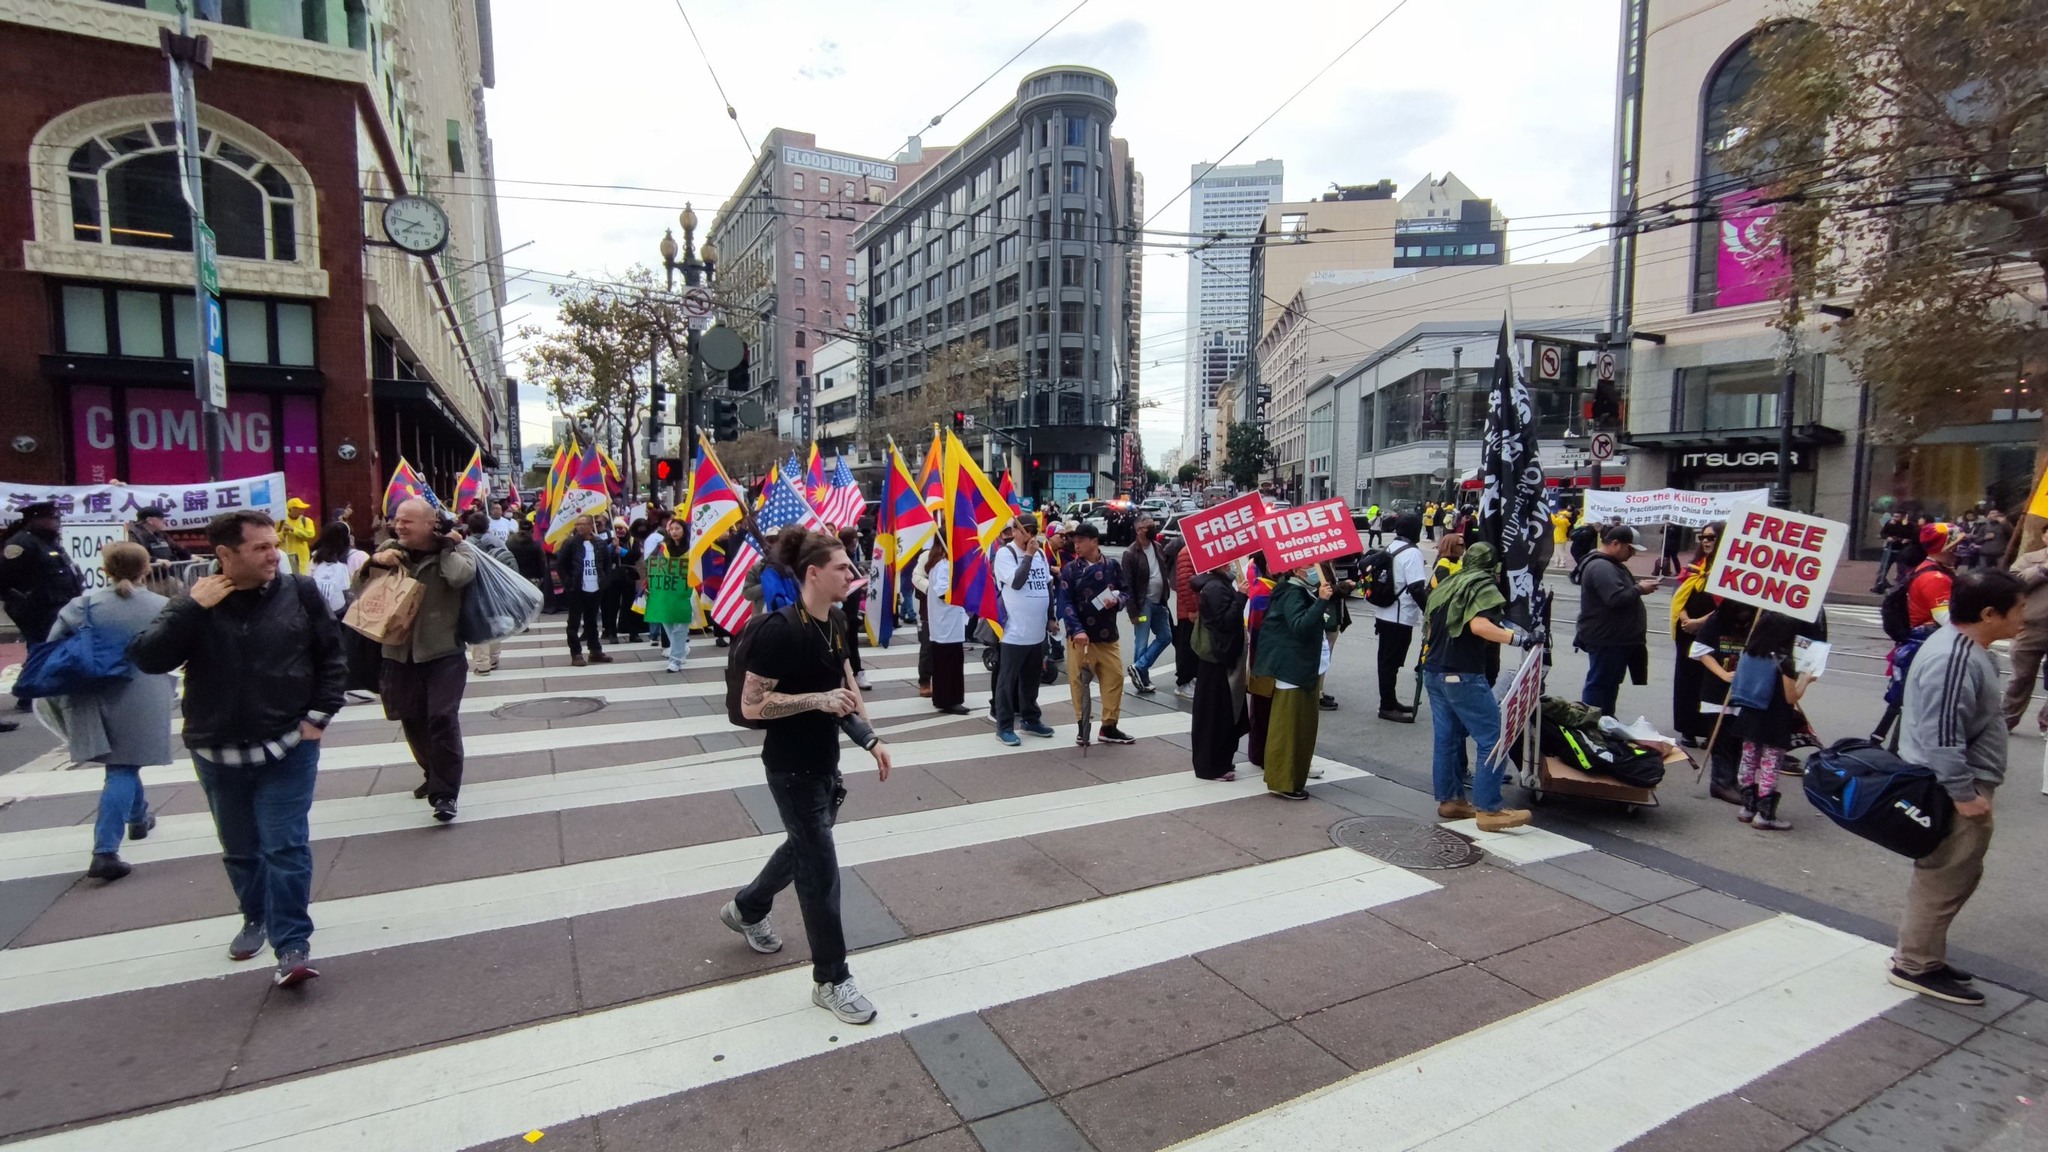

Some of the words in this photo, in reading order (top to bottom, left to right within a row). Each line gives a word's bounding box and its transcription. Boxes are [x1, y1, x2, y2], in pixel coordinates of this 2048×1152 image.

[787, 150, 831, 168] FLOOD
[831, 158, 894, 180] BUILDING
[393, 209, 402, 217] 10
[411, 200, 420, 209] 12
[391, 217, 397, 225] 9
[433, 213, 438, 221] 2
[435, 223, 441, 231] 3
[424, 238, 430, 246] 5
[210, 304, 220, 346] P
[1256, 397, 1264, 459] PARKIG
[1613, 506, 1628, 514] Gong
[1630, 504, 1671, 512] Practitioners
[1682, 506, 1701, 514] China
[1625, 494, 1649, 504] Stop
[1653, 492, 1670, 501] the
[1674, 493, 1708, 506] Killing
[1195, 505, 1254, 541] FREE
[1258, 502, 1344, 539] TIBET
[1201, 525, 1258, 557] TIBET
[1276, 530, 1327, 550] belongs
[1328, 528, 1342, 537] to
[1742, 512, 1827, 552] FREE
[1280, 539, 1347, 563] TIBETANS
[1727, 538, 1821, 581] HONG
[648, 558, 688, 576] FREE
[648, 575, 688, 591] TIBET
[1028, 580, 1047, 590] TIBE
[1719, 565, 1810, 609] KONG
[1894, 800, 1931, 828] FILA
